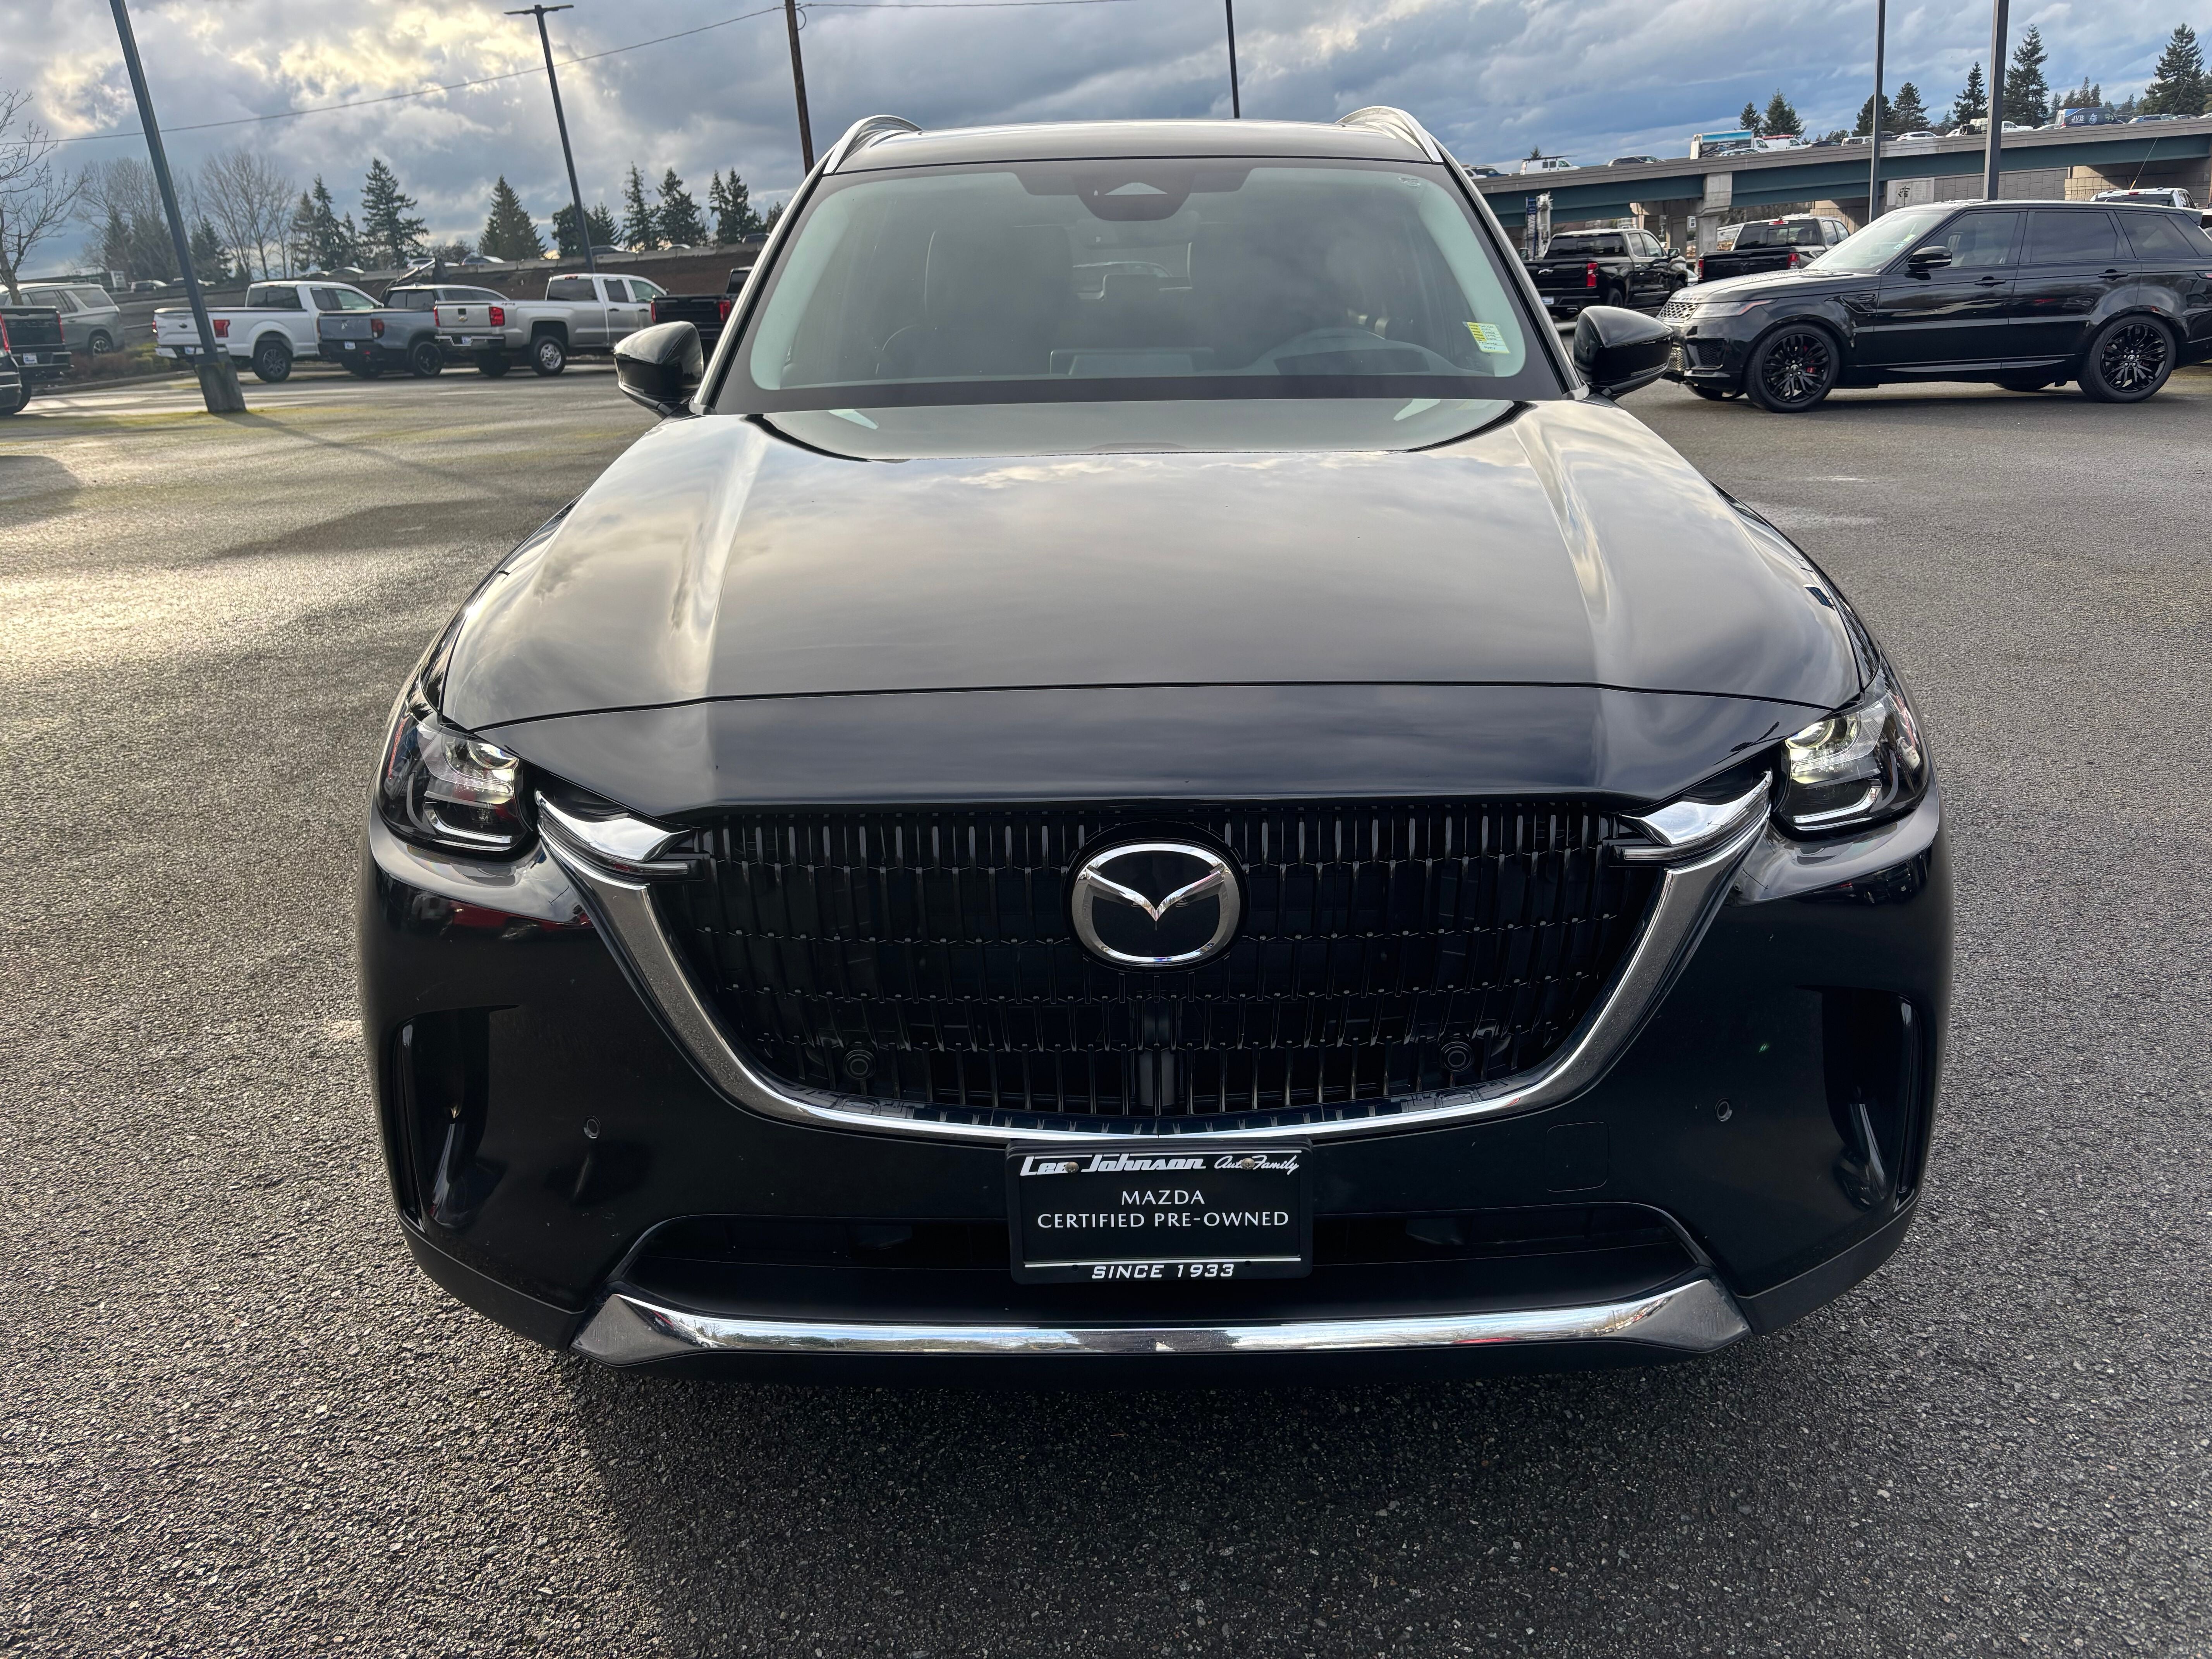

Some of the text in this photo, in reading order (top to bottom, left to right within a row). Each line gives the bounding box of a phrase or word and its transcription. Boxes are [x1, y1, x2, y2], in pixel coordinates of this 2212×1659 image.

[1020, 1154, 1299, 1176] Lee Johnson Aut Family
[1121, 1190, 1205, 1205] MAZDA
[1037, 1211, 1289, 1228] CERTIFIED PRE-OWNED
[1092, 1264, 1234, 1279] SINCE 1933
